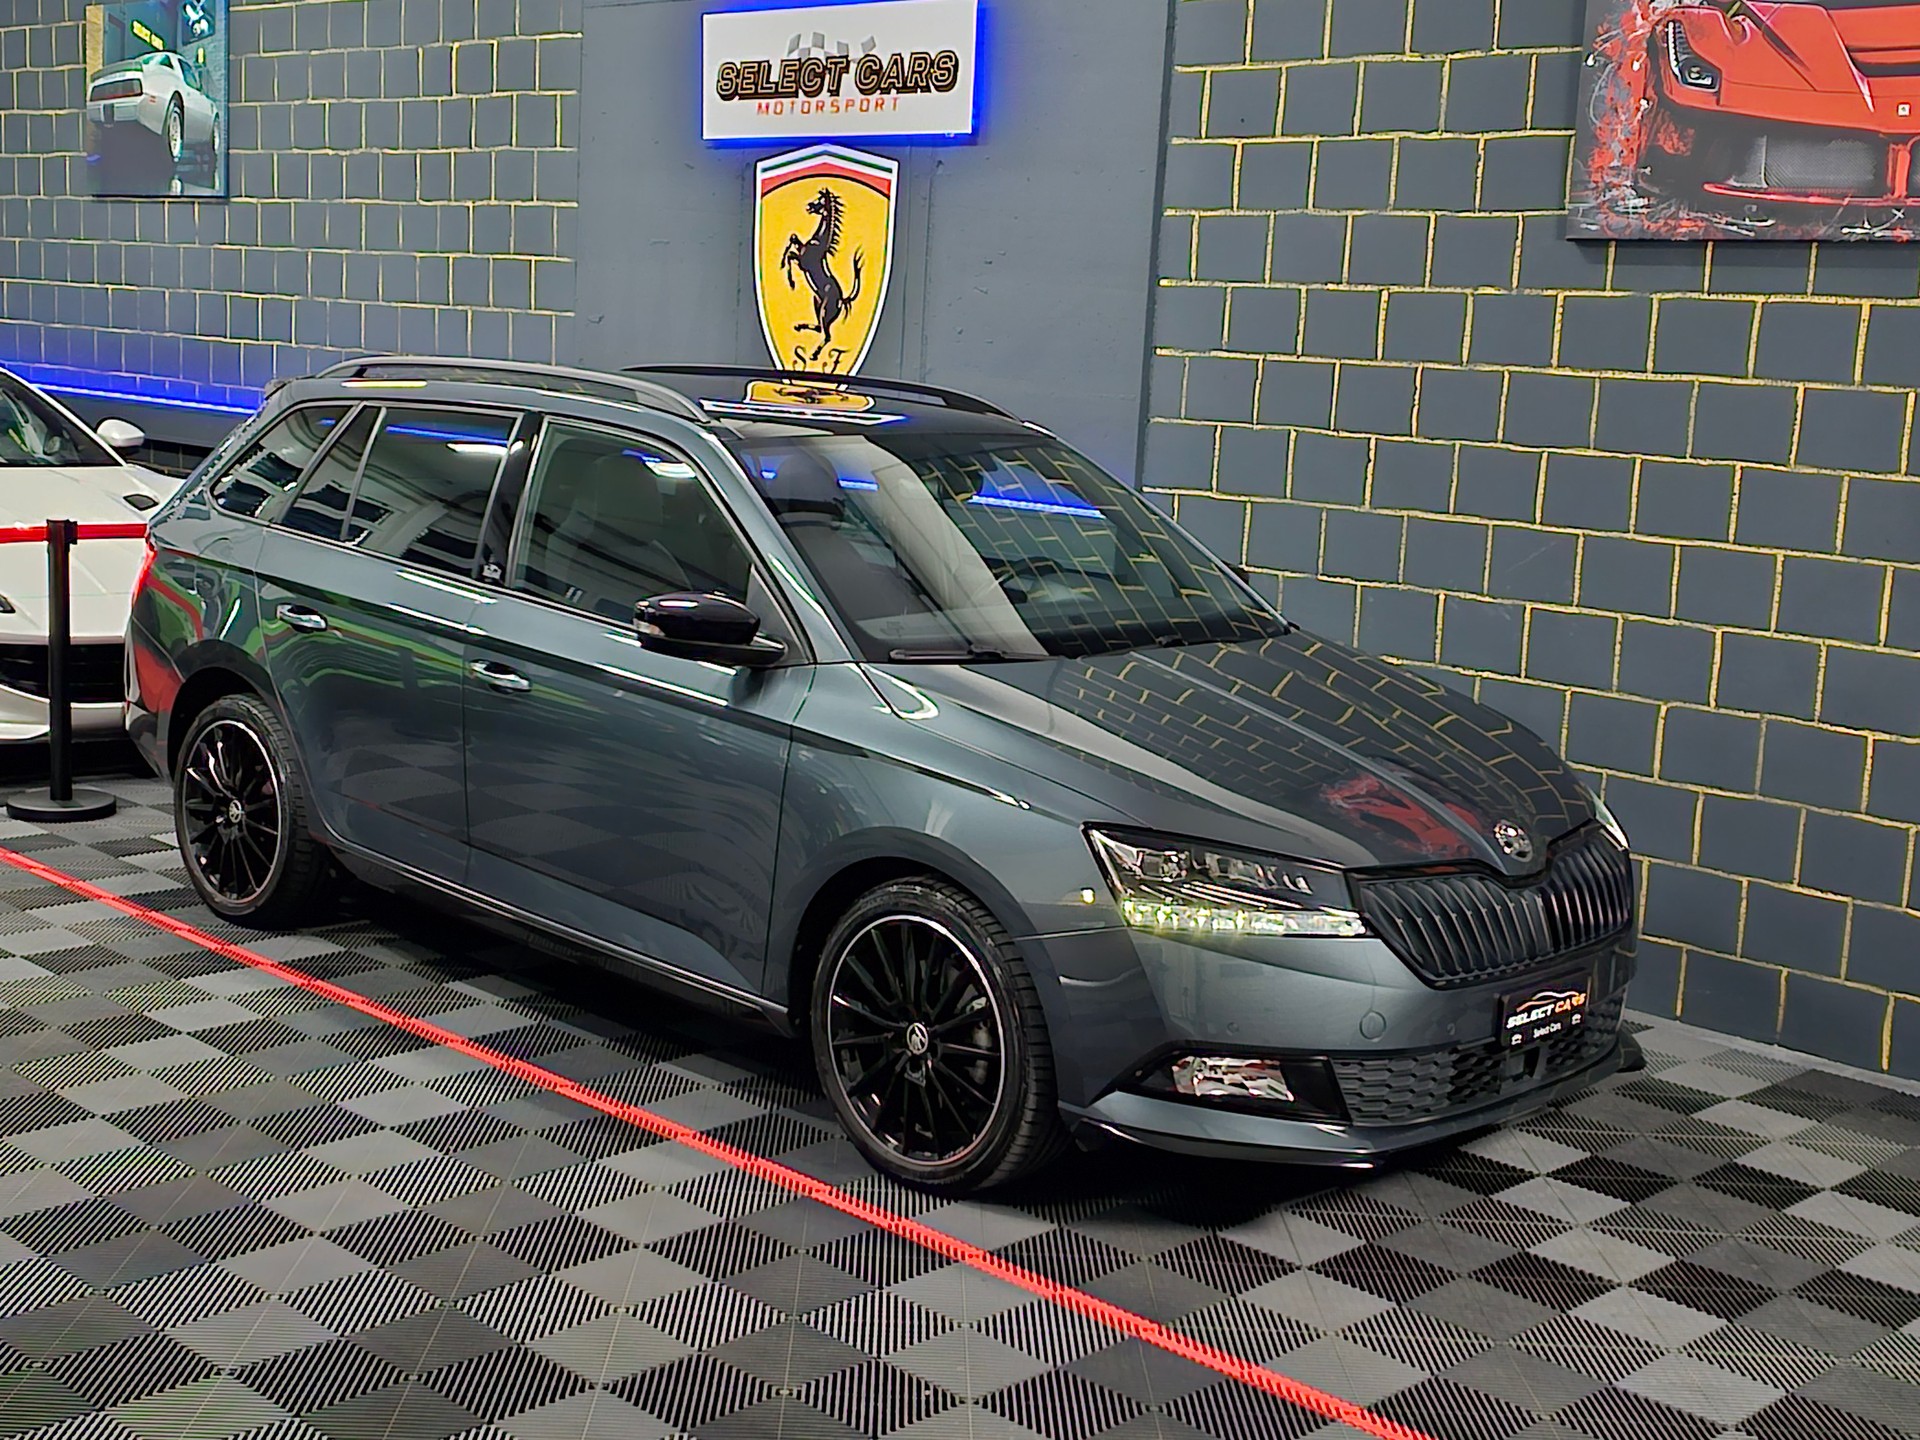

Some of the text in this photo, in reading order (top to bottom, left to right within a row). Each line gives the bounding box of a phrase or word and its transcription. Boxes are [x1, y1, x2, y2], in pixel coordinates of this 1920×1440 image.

[717, 50, 959, 100] SELECT CARS
[756, 97, 900, 115] MOTORSPORT
[1507, 993, 1587, 1028] SELECT CARS
